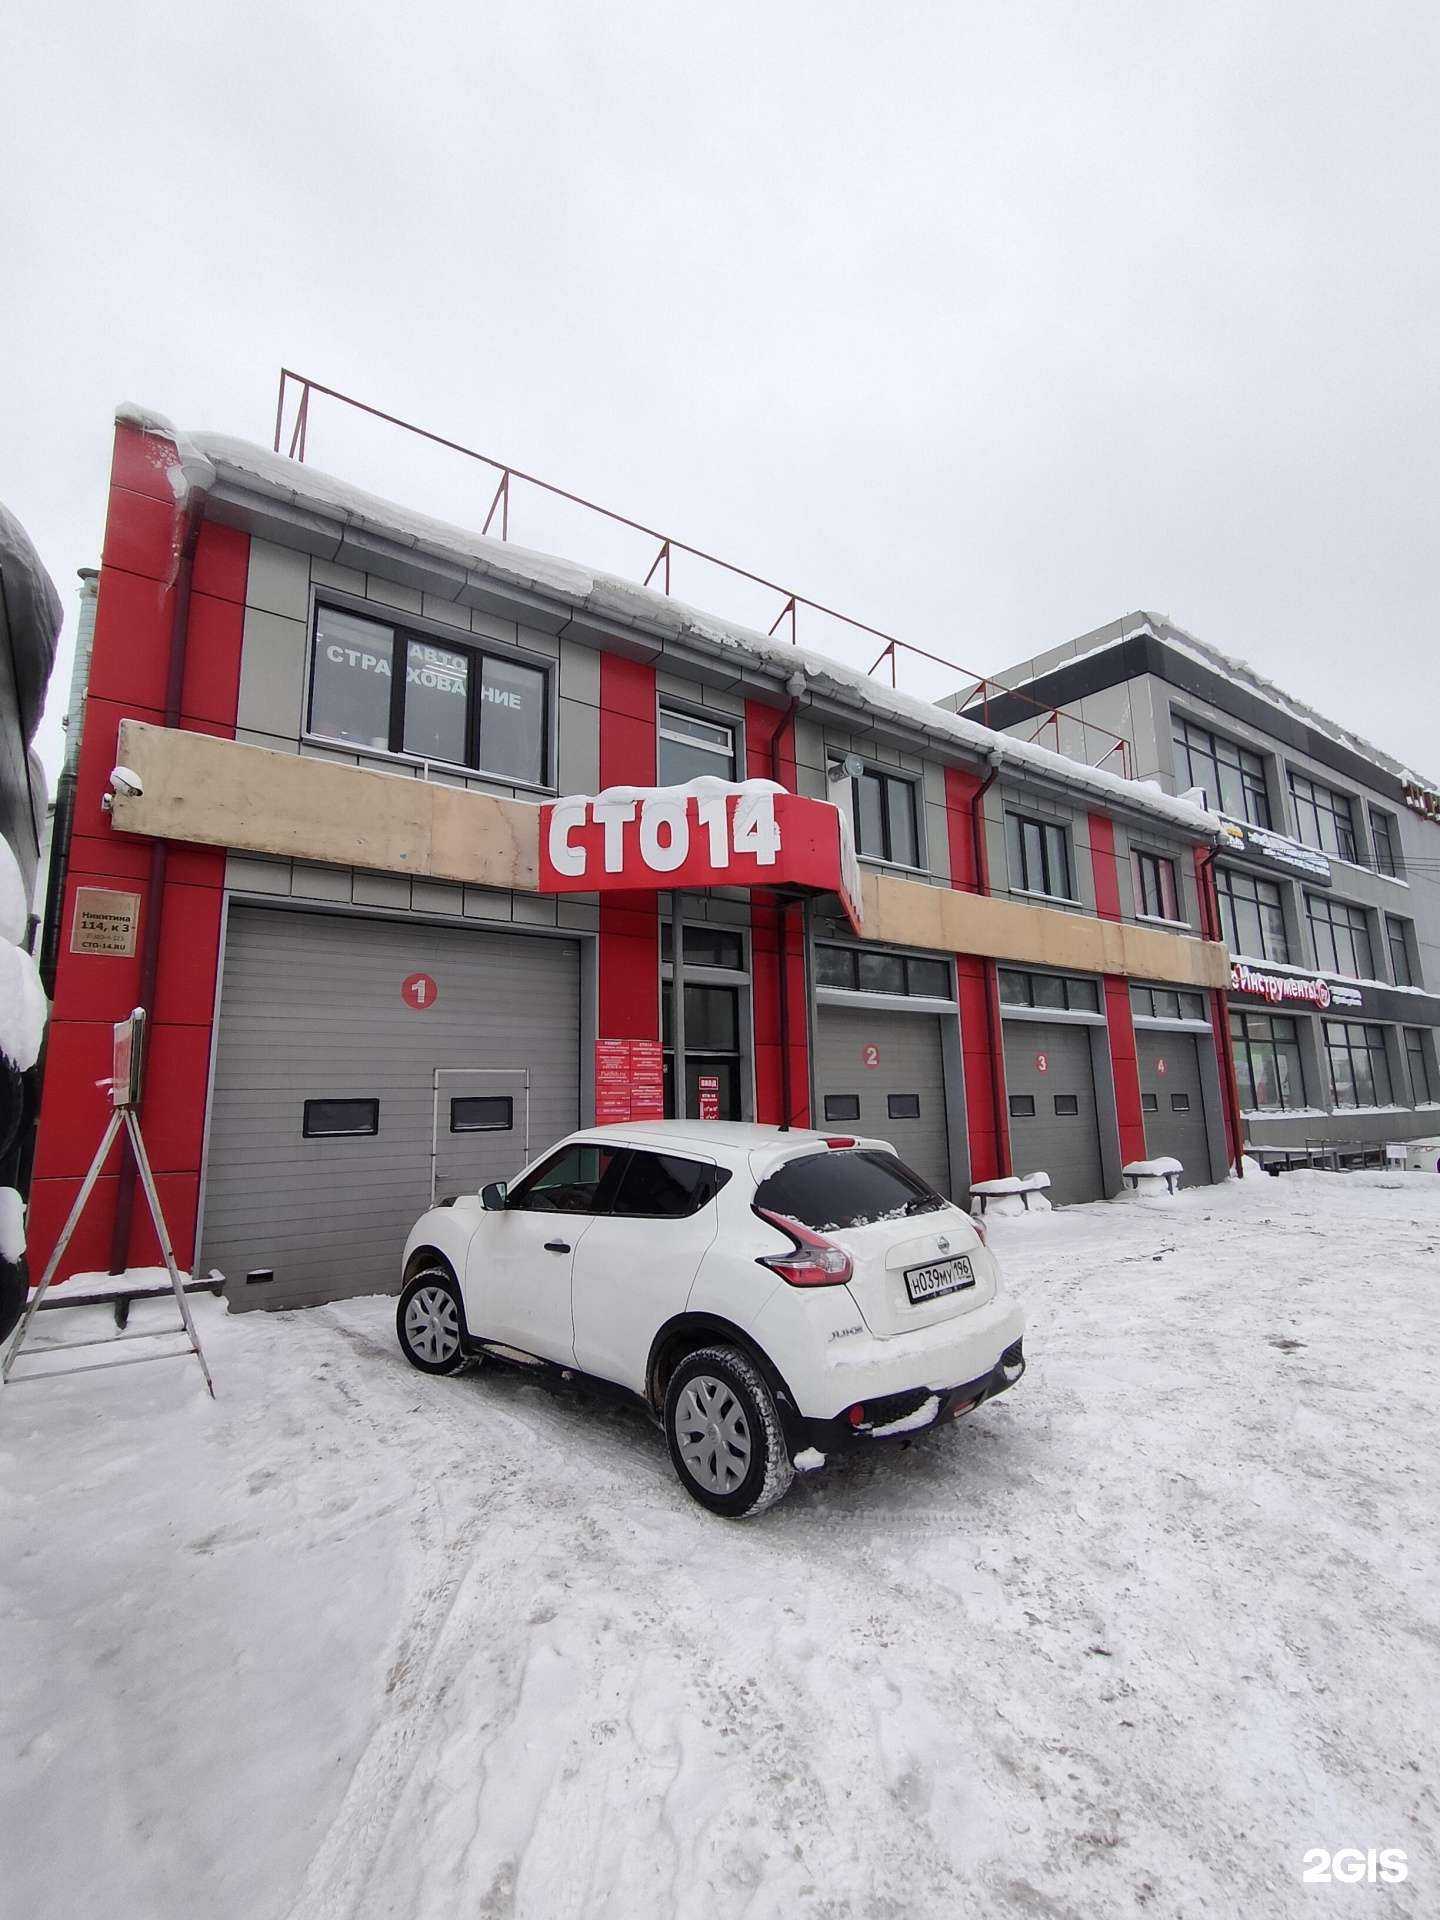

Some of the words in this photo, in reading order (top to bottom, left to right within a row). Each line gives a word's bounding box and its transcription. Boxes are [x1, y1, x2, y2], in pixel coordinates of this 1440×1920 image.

[408, 644, 469, 672] АВТО
[122, 924, 130, 933] 3
[411, 979, 426, 1004] 1
[866, 1047, 879, 1065] 2
[1037, 1055, 1048, 1071] 3
[1157, 1059, 1166, 1073] 4
[953, 1259, 970, 1276] 196
